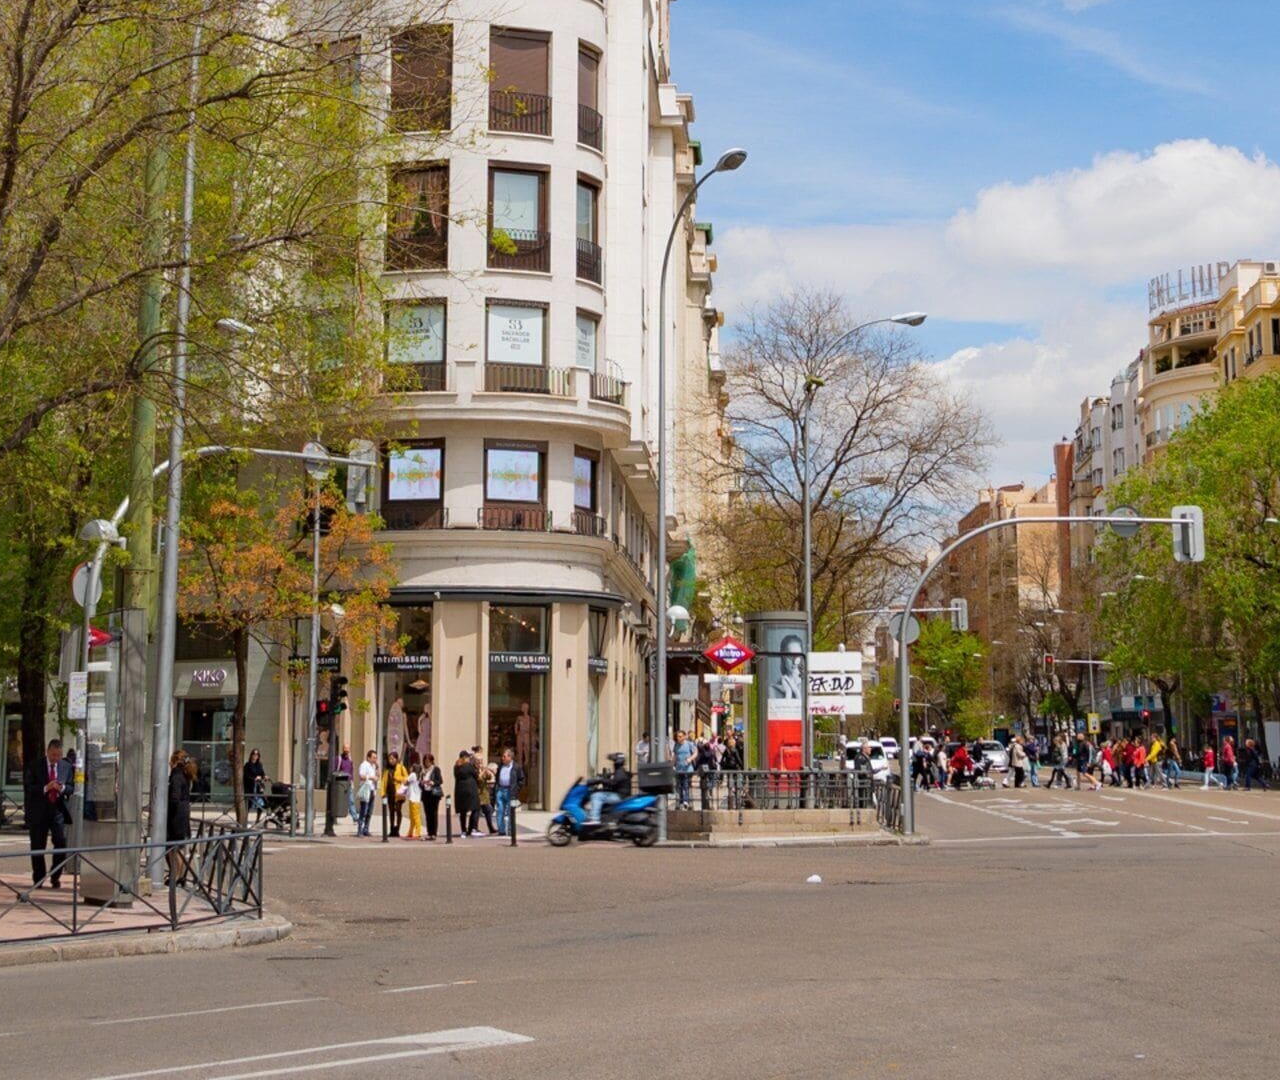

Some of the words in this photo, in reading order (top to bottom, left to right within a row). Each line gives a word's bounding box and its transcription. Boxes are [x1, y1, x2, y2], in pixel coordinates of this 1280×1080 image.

[374, 655, 432, 664] intimissimi
[490, 654, 550, 663] intimissimi
[193, 668, 227, 682] KIKO
